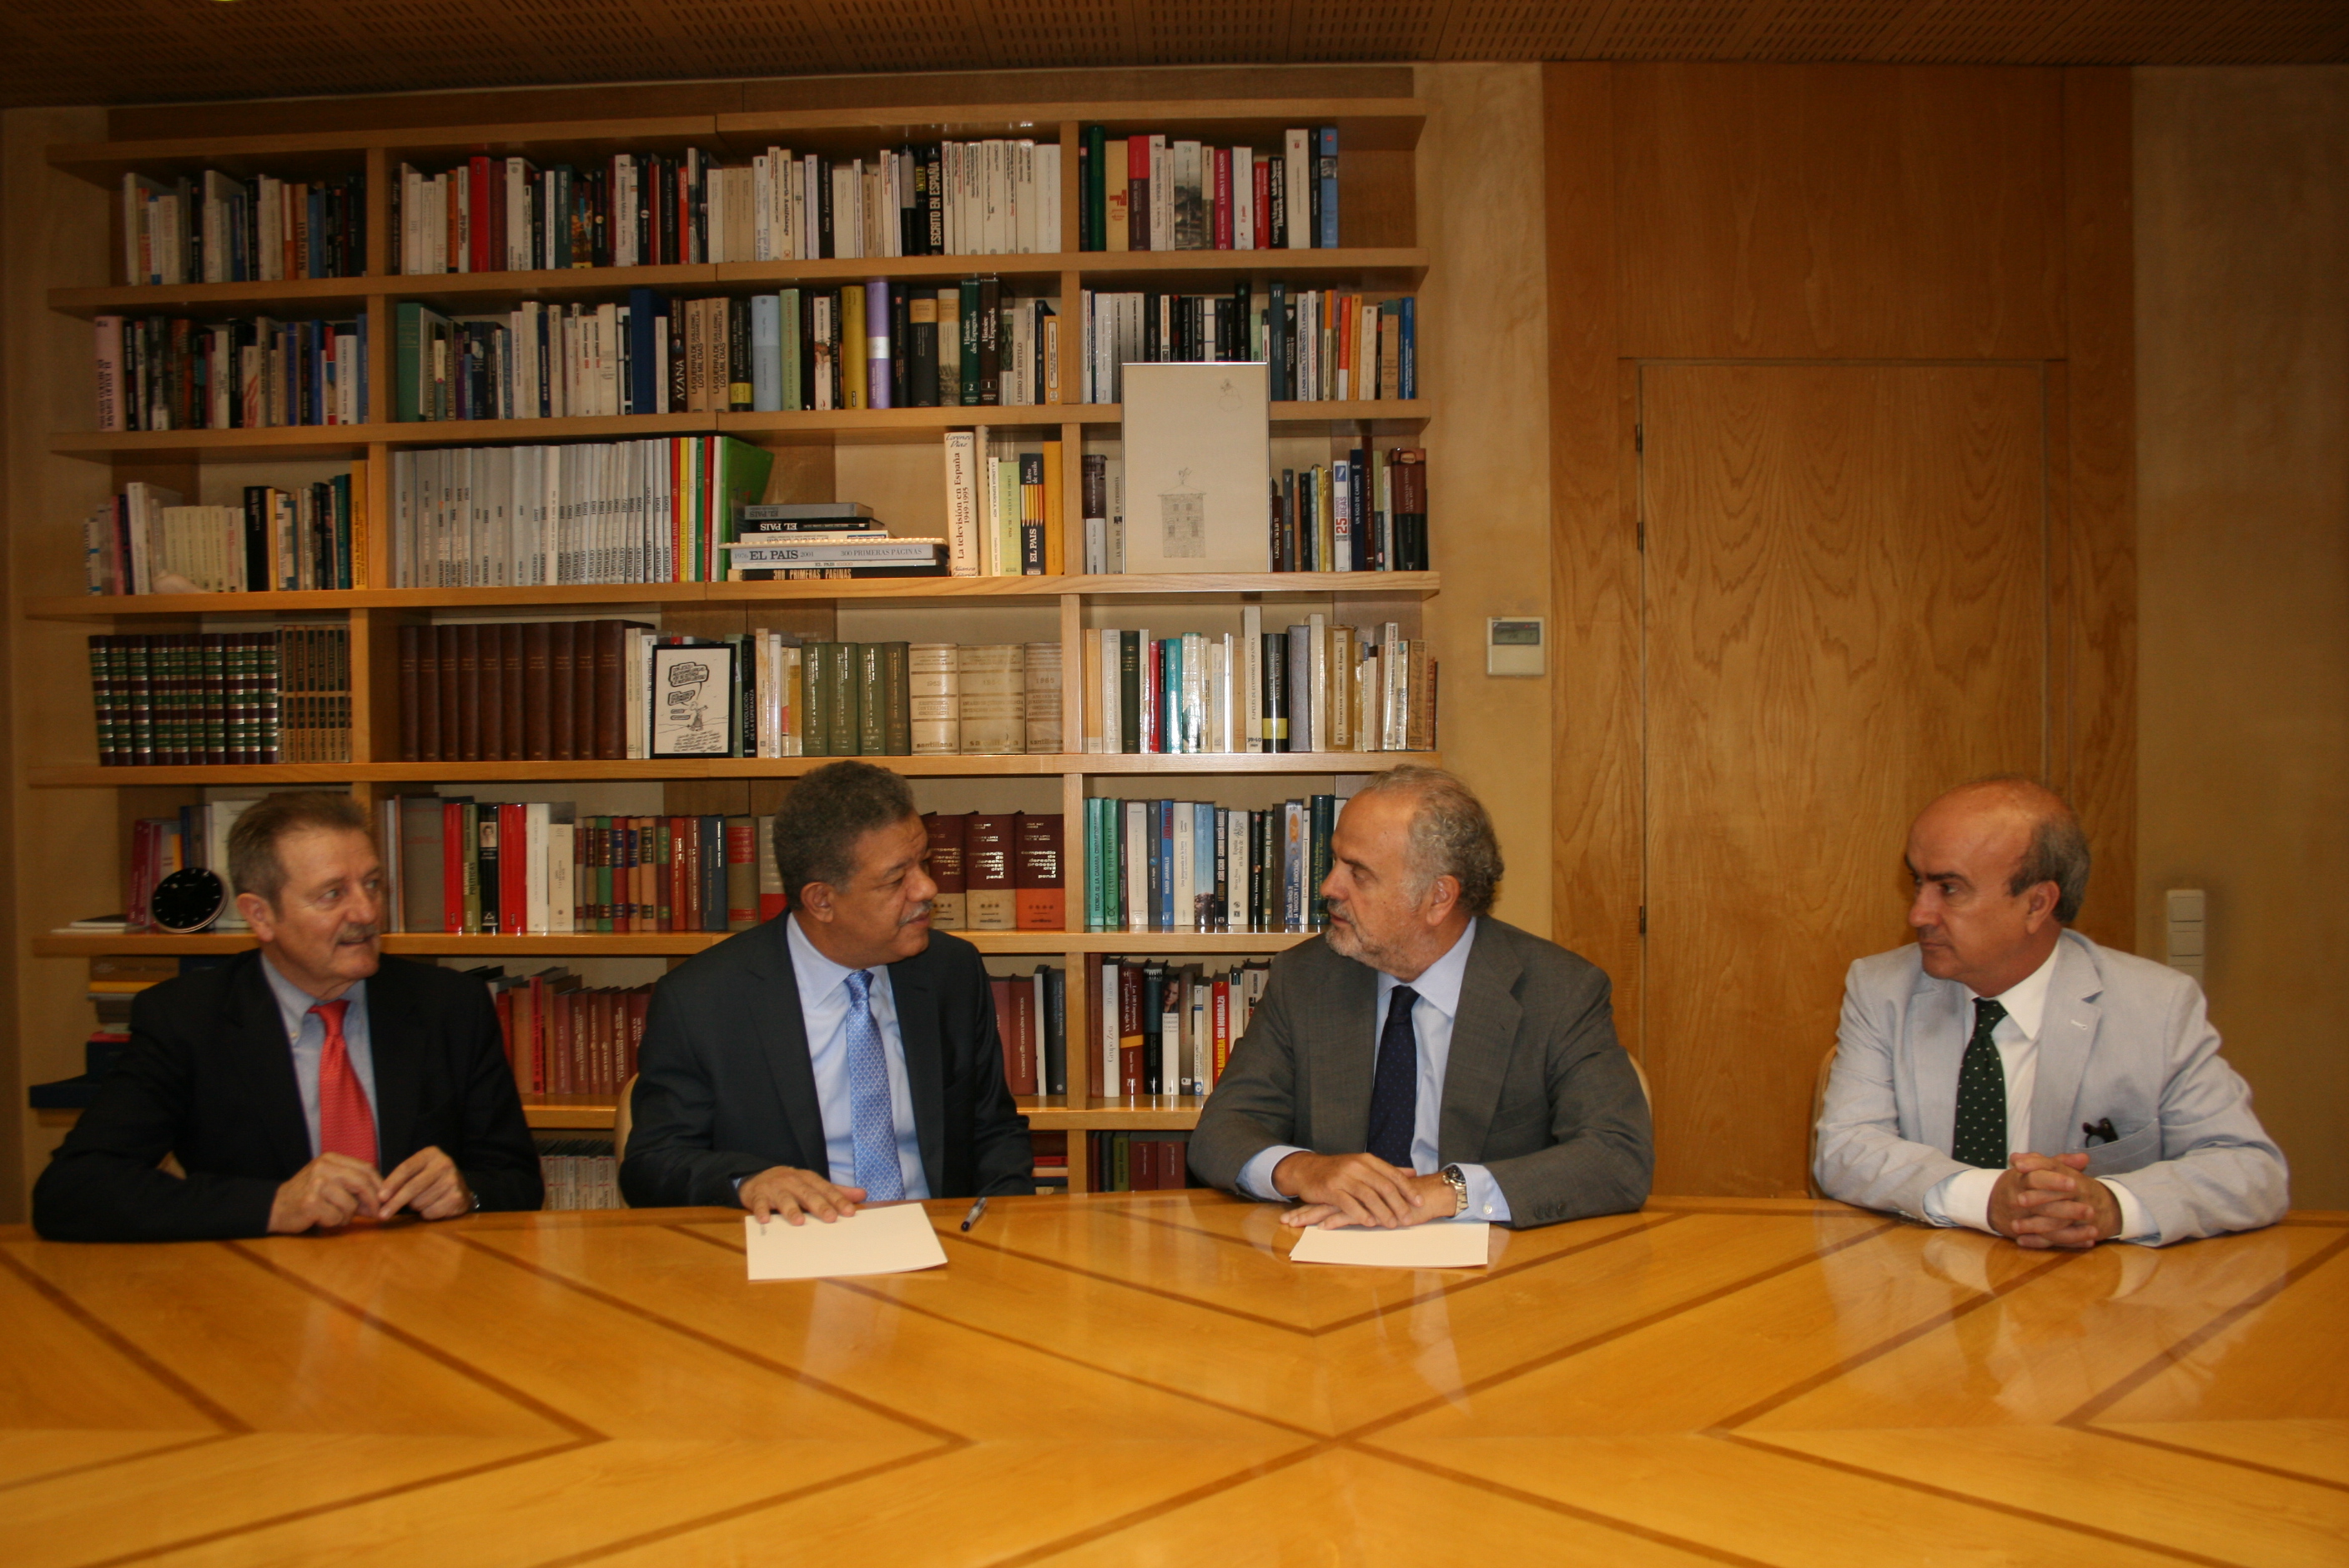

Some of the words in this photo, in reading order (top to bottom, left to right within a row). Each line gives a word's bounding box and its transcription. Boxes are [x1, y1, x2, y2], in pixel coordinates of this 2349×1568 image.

[927, 161, 940, 195] ESPAÑA
[929, 197, 941, 209] EN
[930, 211, 942, 246] ESCRITO
[298, 221, 307, 271] Maragall
[691, 343, 697, 353] DE
[712, 343, 719, 353] DE
[1017, 368, 1023, 379] DE
[691, 384, 697, 395] LA
[712, 384, 719, 395] LA
[953, 452, 962, 485] España
[955, 488, 961, 499] en
[954, 502, 963, 546] televisión
[1336, 517, 1347, 534] 25
[750, 551, 768, 560] EL
[771, 550, 799, 559] PAIS
[958, 549, 964, 559] La
[1029, 550, 1038, 562] EL
[773, 570, 786, 580] 300
[789, 570, 821, 580] PRIMERAS
[749, 732, 754, 741] DE
[1106, 998, 1113, 1008] 30
